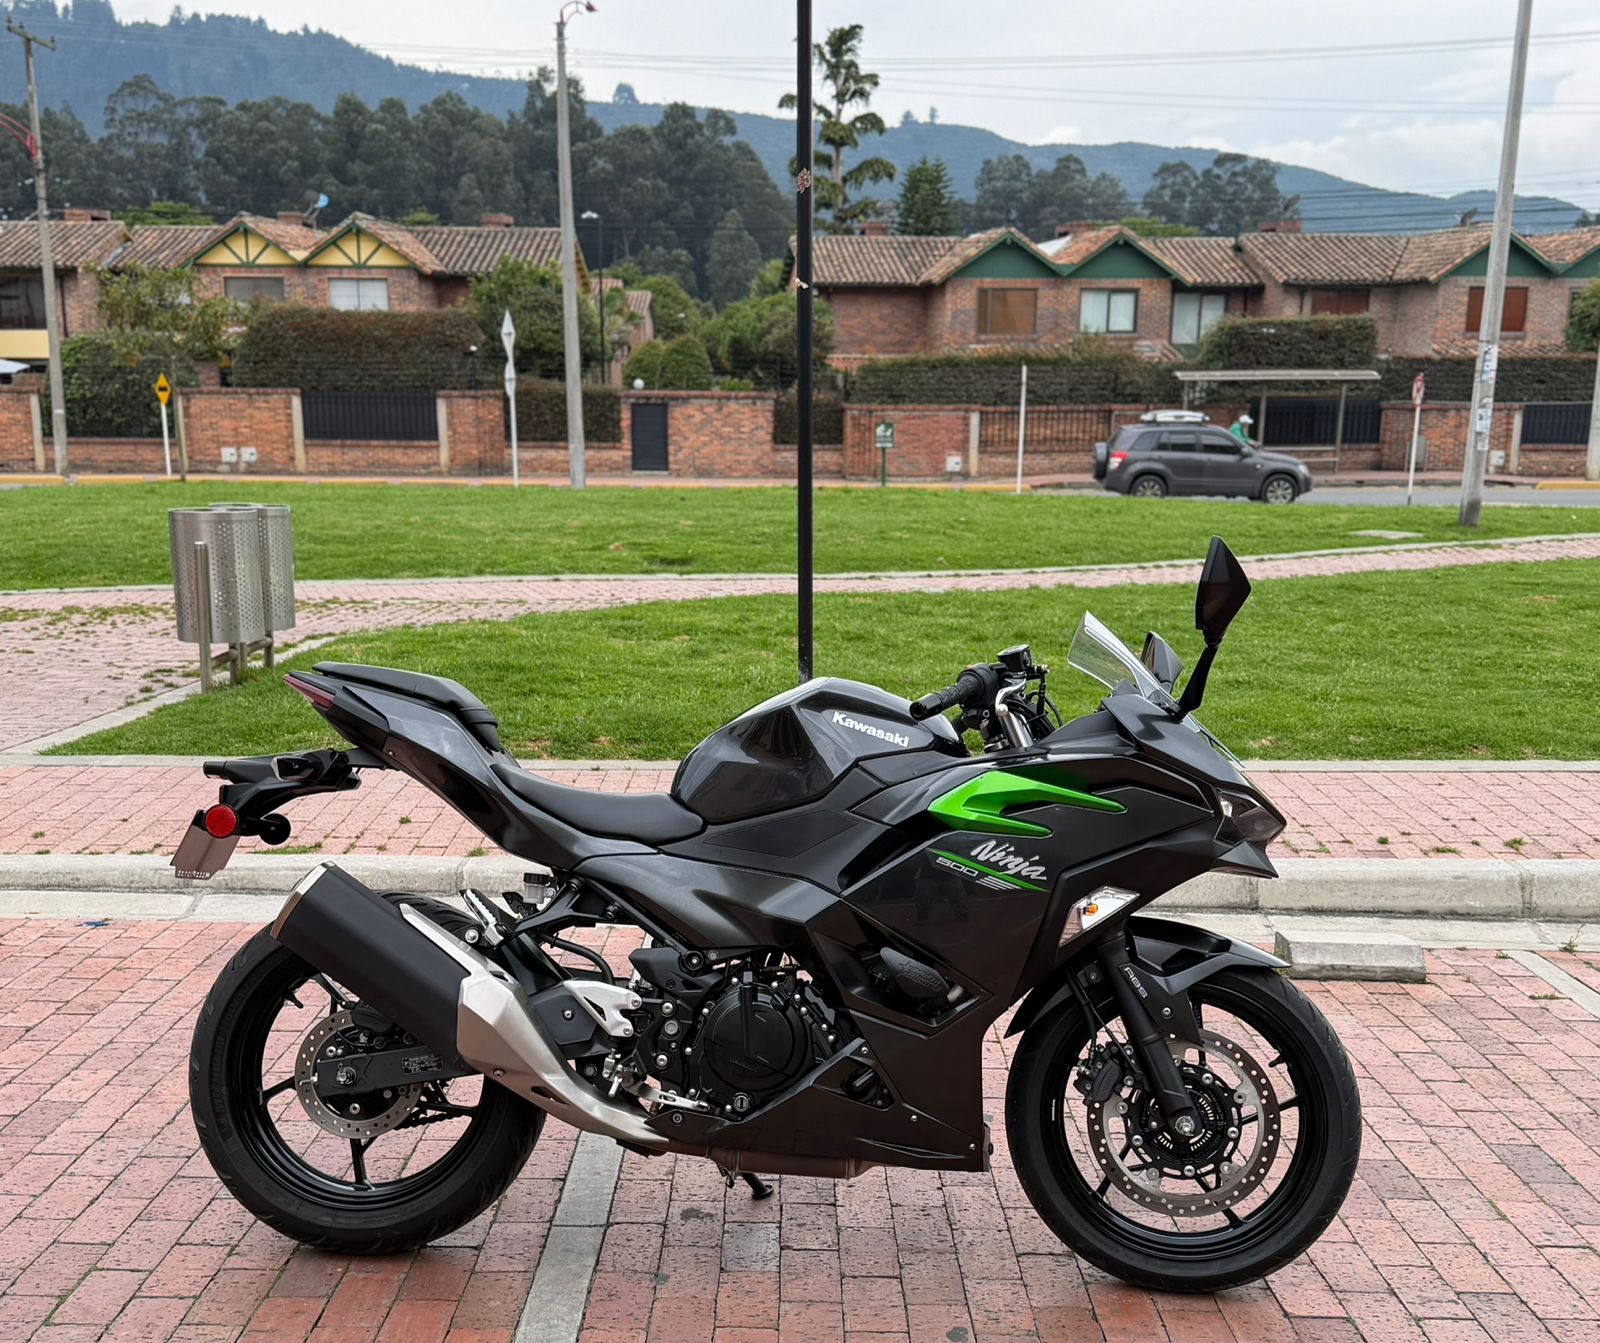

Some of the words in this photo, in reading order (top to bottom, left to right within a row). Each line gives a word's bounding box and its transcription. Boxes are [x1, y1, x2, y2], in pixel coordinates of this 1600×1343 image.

[832, 711, 910, 748] Kawasaki
[970, 839, 1047, 881] Ninja
[1124, 966, 1148, 998] ABS
